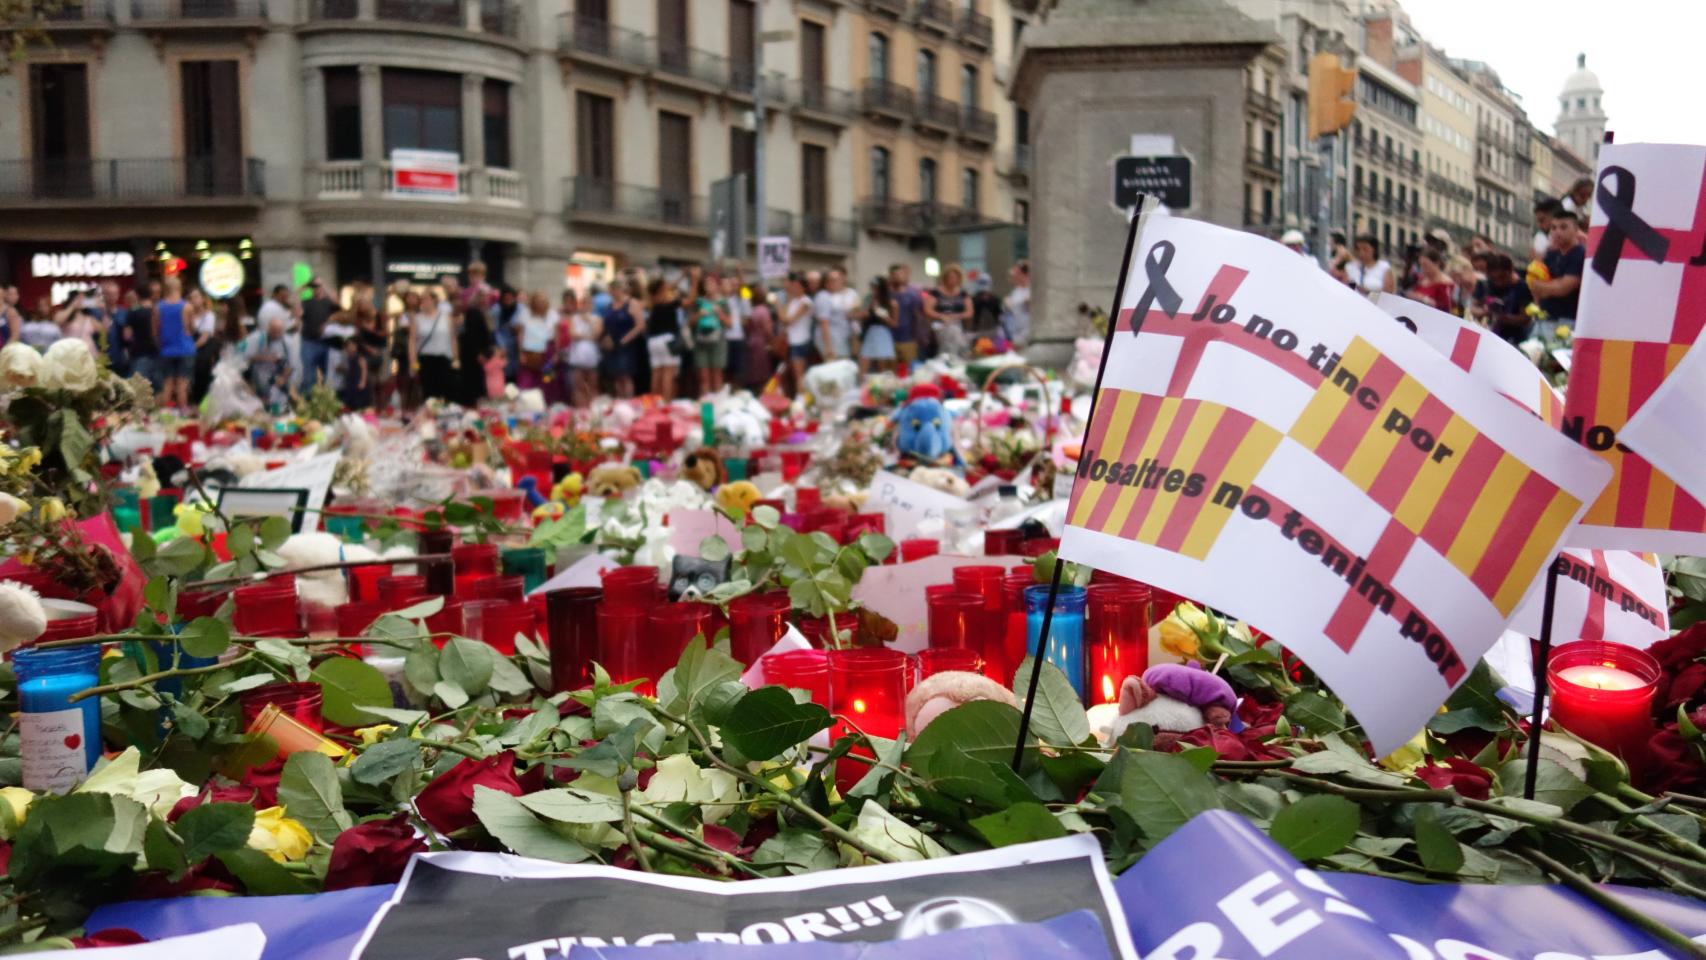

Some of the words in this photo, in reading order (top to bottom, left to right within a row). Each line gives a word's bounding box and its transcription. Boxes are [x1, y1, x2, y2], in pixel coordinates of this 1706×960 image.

[32, 252, 134, 277] BURGER
[1191, 294, 1236, 324] Jo
[1243, 314, 1299, 351] no
[1307, 342, 1380, 411] tinc
[1382, 407, 1454, 463] por
[1211, 481, 1271, 520] no
[1280, 509, 1396, 616] tenim
[1399, 611, 1459, 676] por
[1556, 556, 1615, 602] enim
[1620, 591, 1658, 626] por
